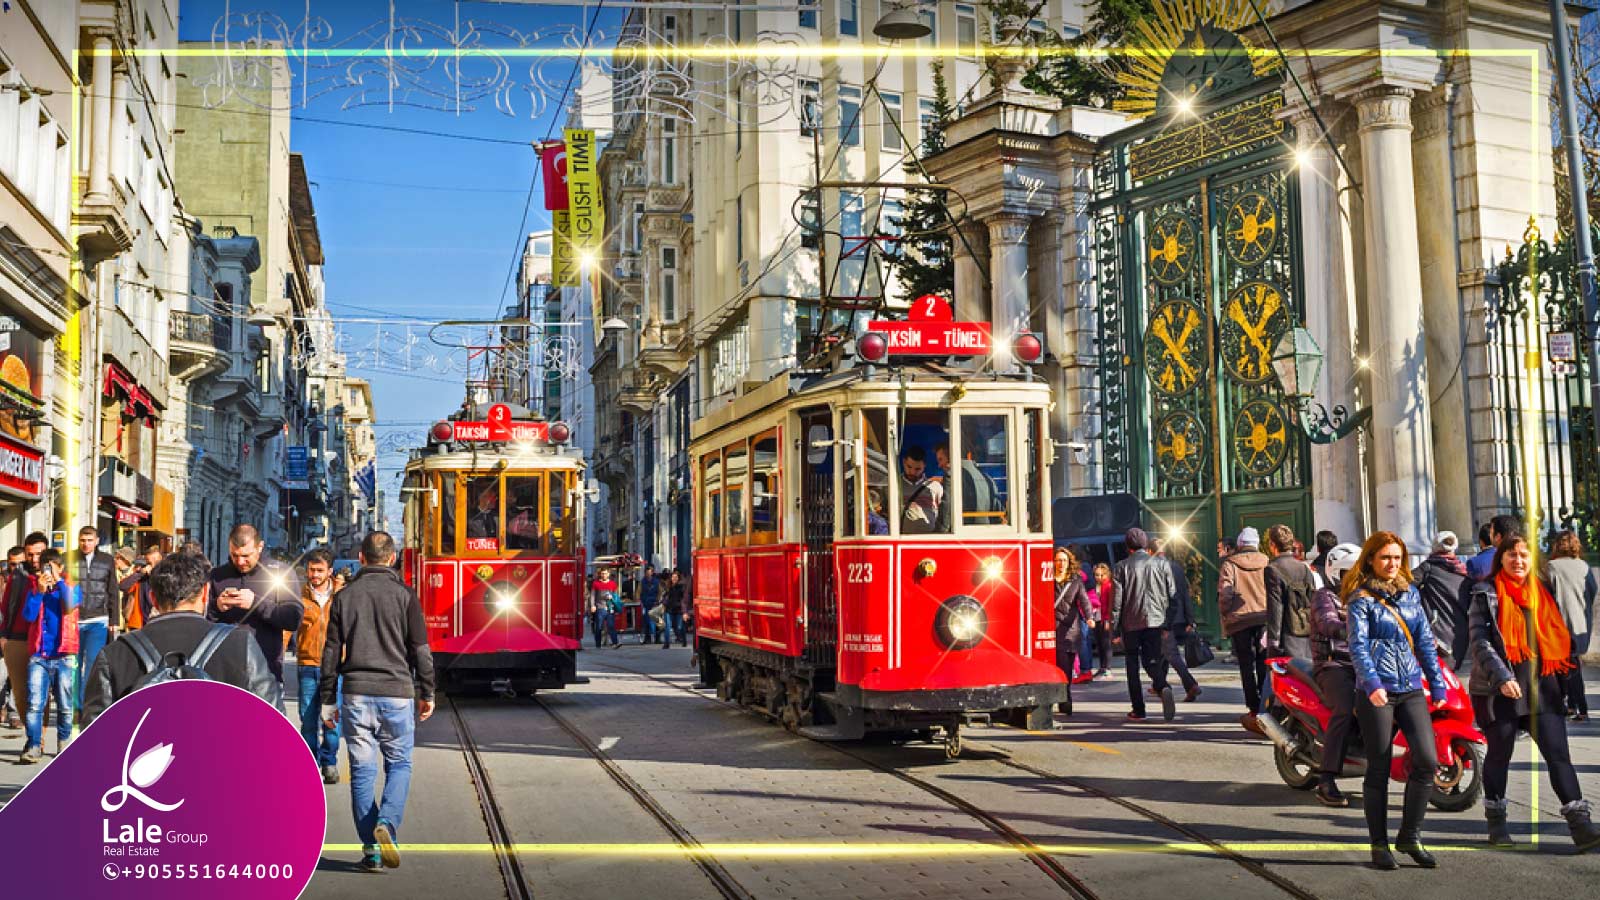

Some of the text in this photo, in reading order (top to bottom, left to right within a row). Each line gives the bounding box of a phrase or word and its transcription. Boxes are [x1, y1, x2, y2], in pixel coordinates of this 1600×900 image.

[572, 133, 594, 250] NGLISH TIME
[925, 297, 936, 317] 2
[888, 327, 922, 347] KSİM
[943, 328, 986, 348] TÜNEL
[495, 406, 504, 420] 3
[456, 424, 489, 440] TAKSİM
[512, 424, 542, 440] TÜNEL
[848, 562, 873, 583] 223
